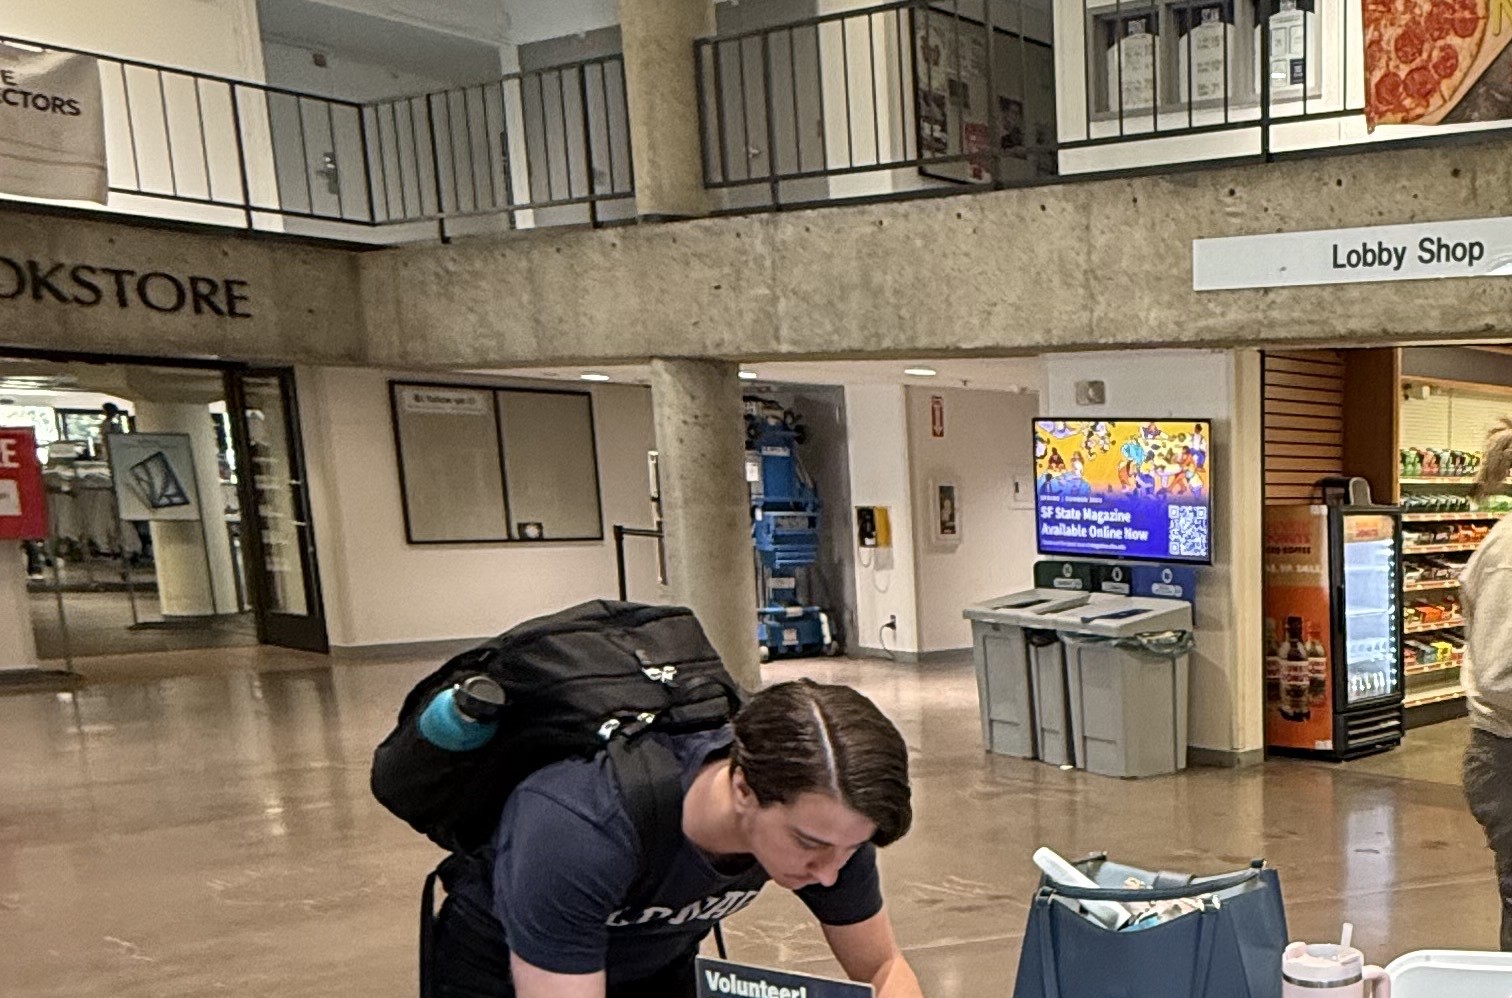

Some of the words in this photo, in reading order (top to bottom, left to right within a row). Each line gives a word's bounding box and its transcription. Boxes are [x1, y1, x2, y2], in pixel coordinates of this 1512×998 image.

[0, 88, 82, 116] CTORS
[1332, 240, 1407, 271] Lobby
[1417, 236, 1485, 267] Shop
[1040, 505, 1054, 519] SF
[1055, 507, 1081, 520] State
[1083, 508, 1131, 524] Magazine
[1041, 523, 1087, 538] Available
[1089, 525, 1122, 540] Online
[1124, 527, 1149, 541] Now
